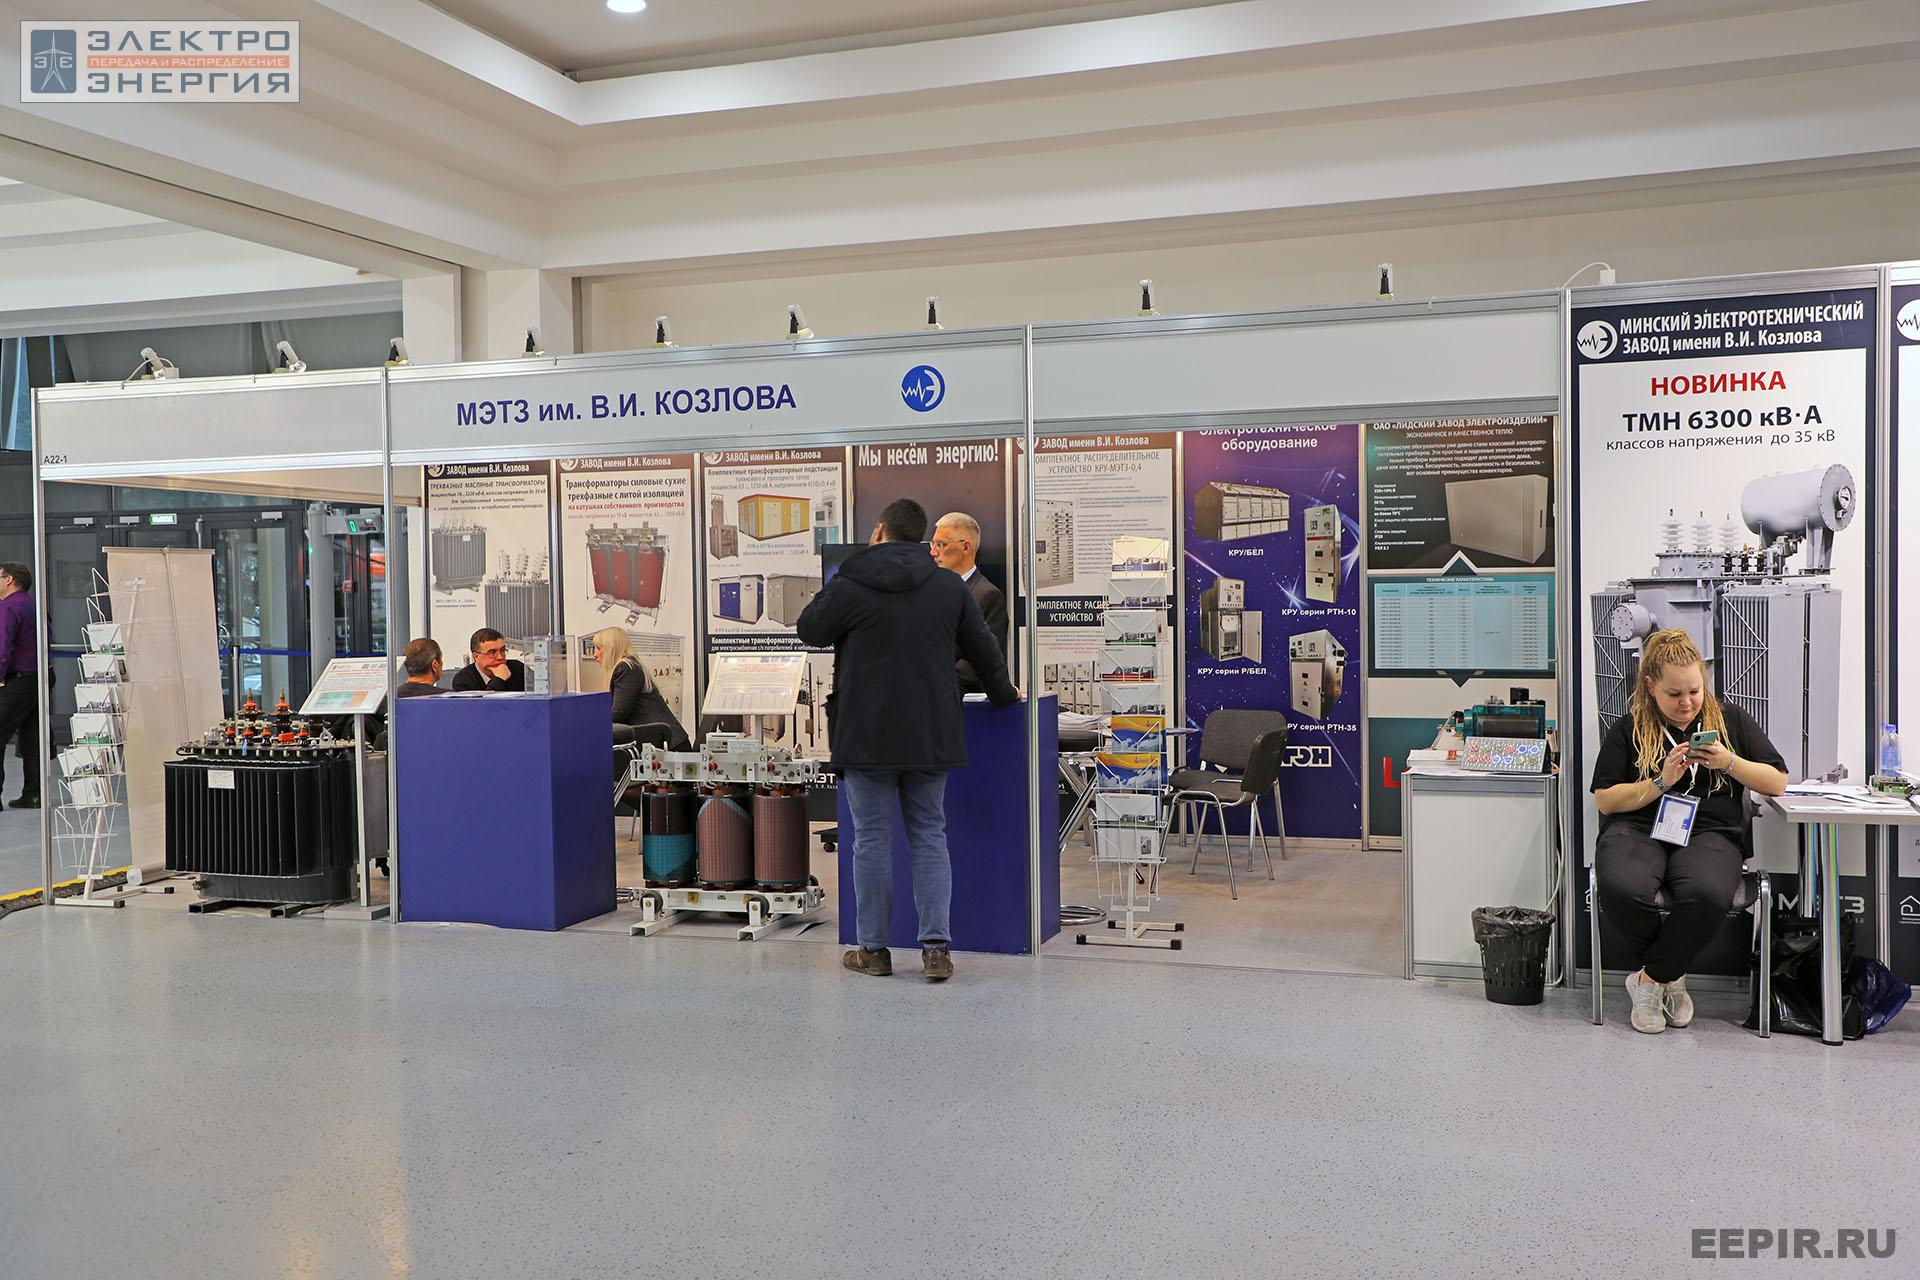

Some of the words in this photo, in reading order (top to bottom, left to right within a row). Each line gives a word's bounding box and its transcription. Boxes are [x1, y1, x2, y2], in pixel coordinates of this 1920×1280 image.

[1620, 312, 1691, 335] МИНСКИЙ
[1694, 301, 1864, 329] ЭЛЕКТРОТЕХНИЧЕСКИЙ
[1623, 335, 1670, 355] ЗАВОД
[1673, 336, 1721, 351] имени
[1725, 333, 1755, 348] В.И.
[1759, 329, 1822, 346] Козлова
[1651, 371, 1786, 396] НОВИНКА
[456, 399, 529, 426] МЭТЗ
[539, 402, 581, 422] им.
[591, 395, 645, 420] В.И.
[655, 384, 797, 415] КОЗЛОВА
[1437, 420, 1464, 428] ЗАВОД
[1623, 412, 1680, 433] ТМН
[1688, 408, 1752, 430] 6300
[1042, 438, 1068, 449] ЗАВОД
[1097, 437, 1113, 446] В.И.
[1115, 437, 1148, 446] Козлова
[1222, 438, 1318, 452] оборудование
[1606, 438, 1664, 450] классов
[1669, 433, 1762, 450] напряжения
[1770, 432, 1790, 446] до
[1795, 430, 1812, 443] 35
[1817, 430, 1835, 442] кВ
[726, 453, 749, 462] ЗАВОД
[775, 451, 789, 460] В.И.
[791, 451, 821, 460] Козлова
[859, 445, 881, 466] Мы
[888, 443, 927, 465] несём
[936, 438, 999, 469] энергию!
[1035, 454, 1080, 464] ОМПЛЕКТНОЕ
[1084, 451, 1159, 462] РАСПРЕДЕЛИТЕЛЬНОЕ
[581, 459, 602, 468] ЗАВОД
[627, 458, 641, 466] В.И.
[642, 457, 671, 465] Козлова
[446, 465, 467, 475] ЗАВОД
[489, 464, 501, 473] В.И.
[503, 464, 529, 472] Козлова
[1048, 464, 1092, 474] УСТРОЙСТВО
[566, 479, 629, 489] Трансформаторы
[665, 477, 686, 485] сухие
[568, 492, 613, 501] трехфазные
[619, 491, 641, 499] литой
[643, 489, 684, 499] изоляцией
[1036, 601, 1081, 610] ОМПЛЕКТНОЕ
[1050, 613, 1093, 622] УСТРОЙСТВО
[1300, 609, 1325, 617] серии
[1300, 724, 1325, 732] серии
